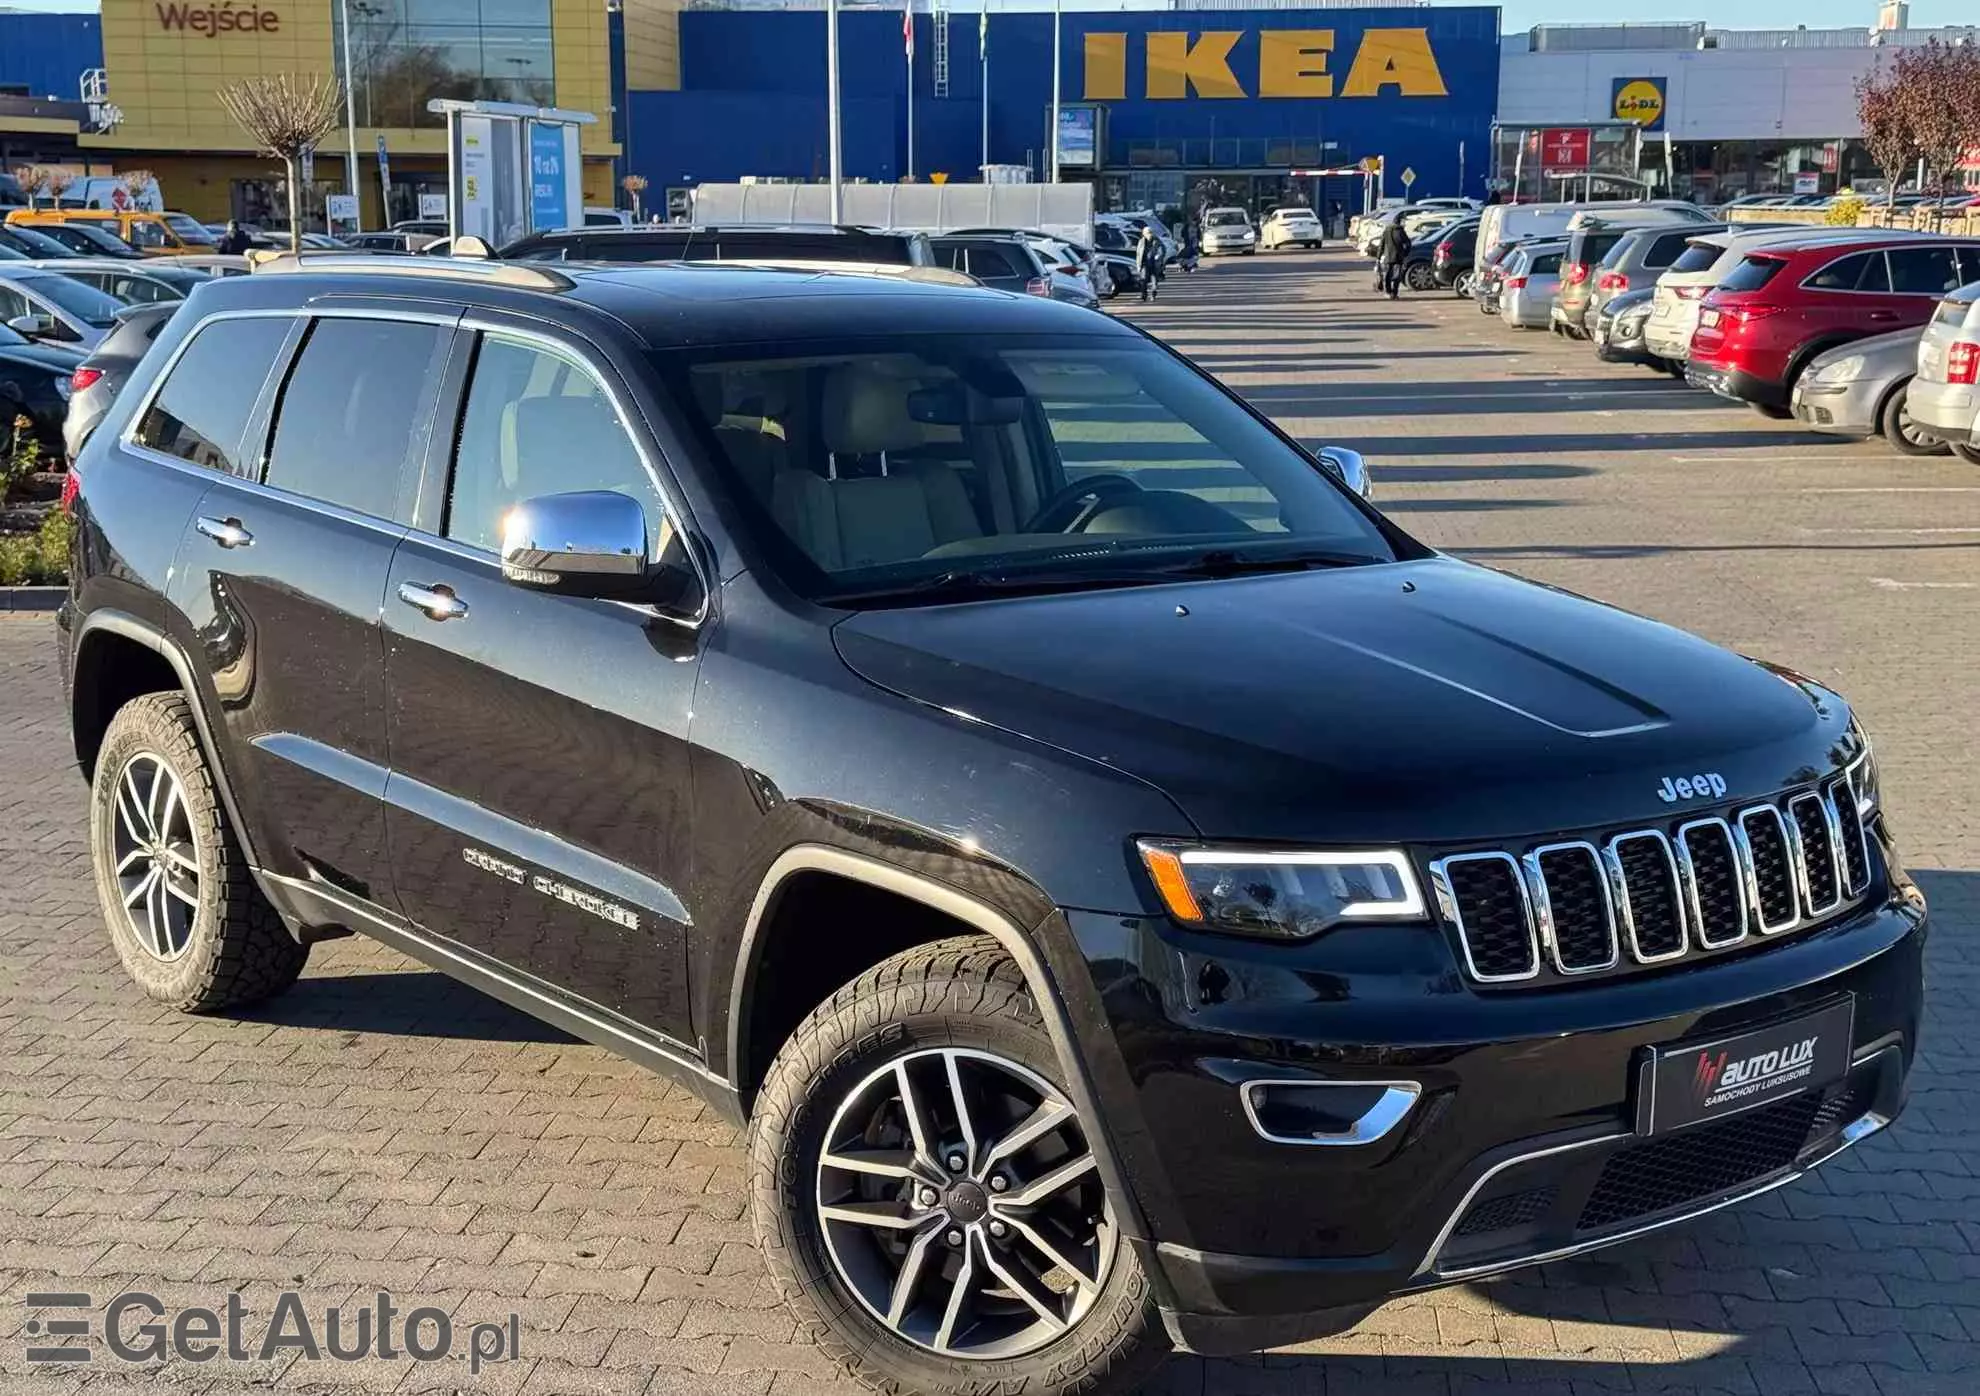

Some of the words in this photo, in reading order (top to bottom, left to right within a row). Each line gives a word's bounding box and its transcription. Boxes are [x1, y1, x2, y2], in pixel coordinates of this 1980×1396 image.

[156, 1, 279, 38] Wejście
[1083, 28, 1449, 99] IKEA
[1657, 772, 1727, 802] Jeep
[1778, 1036, 1818, 1069] LUX
[1704, 1083, 1761, 1108] SAMOCHODY
[1761, 1065, 1813, 1090] LUKSUSOWE
[1043, 1261, 1145, 1388] OUNTRY
